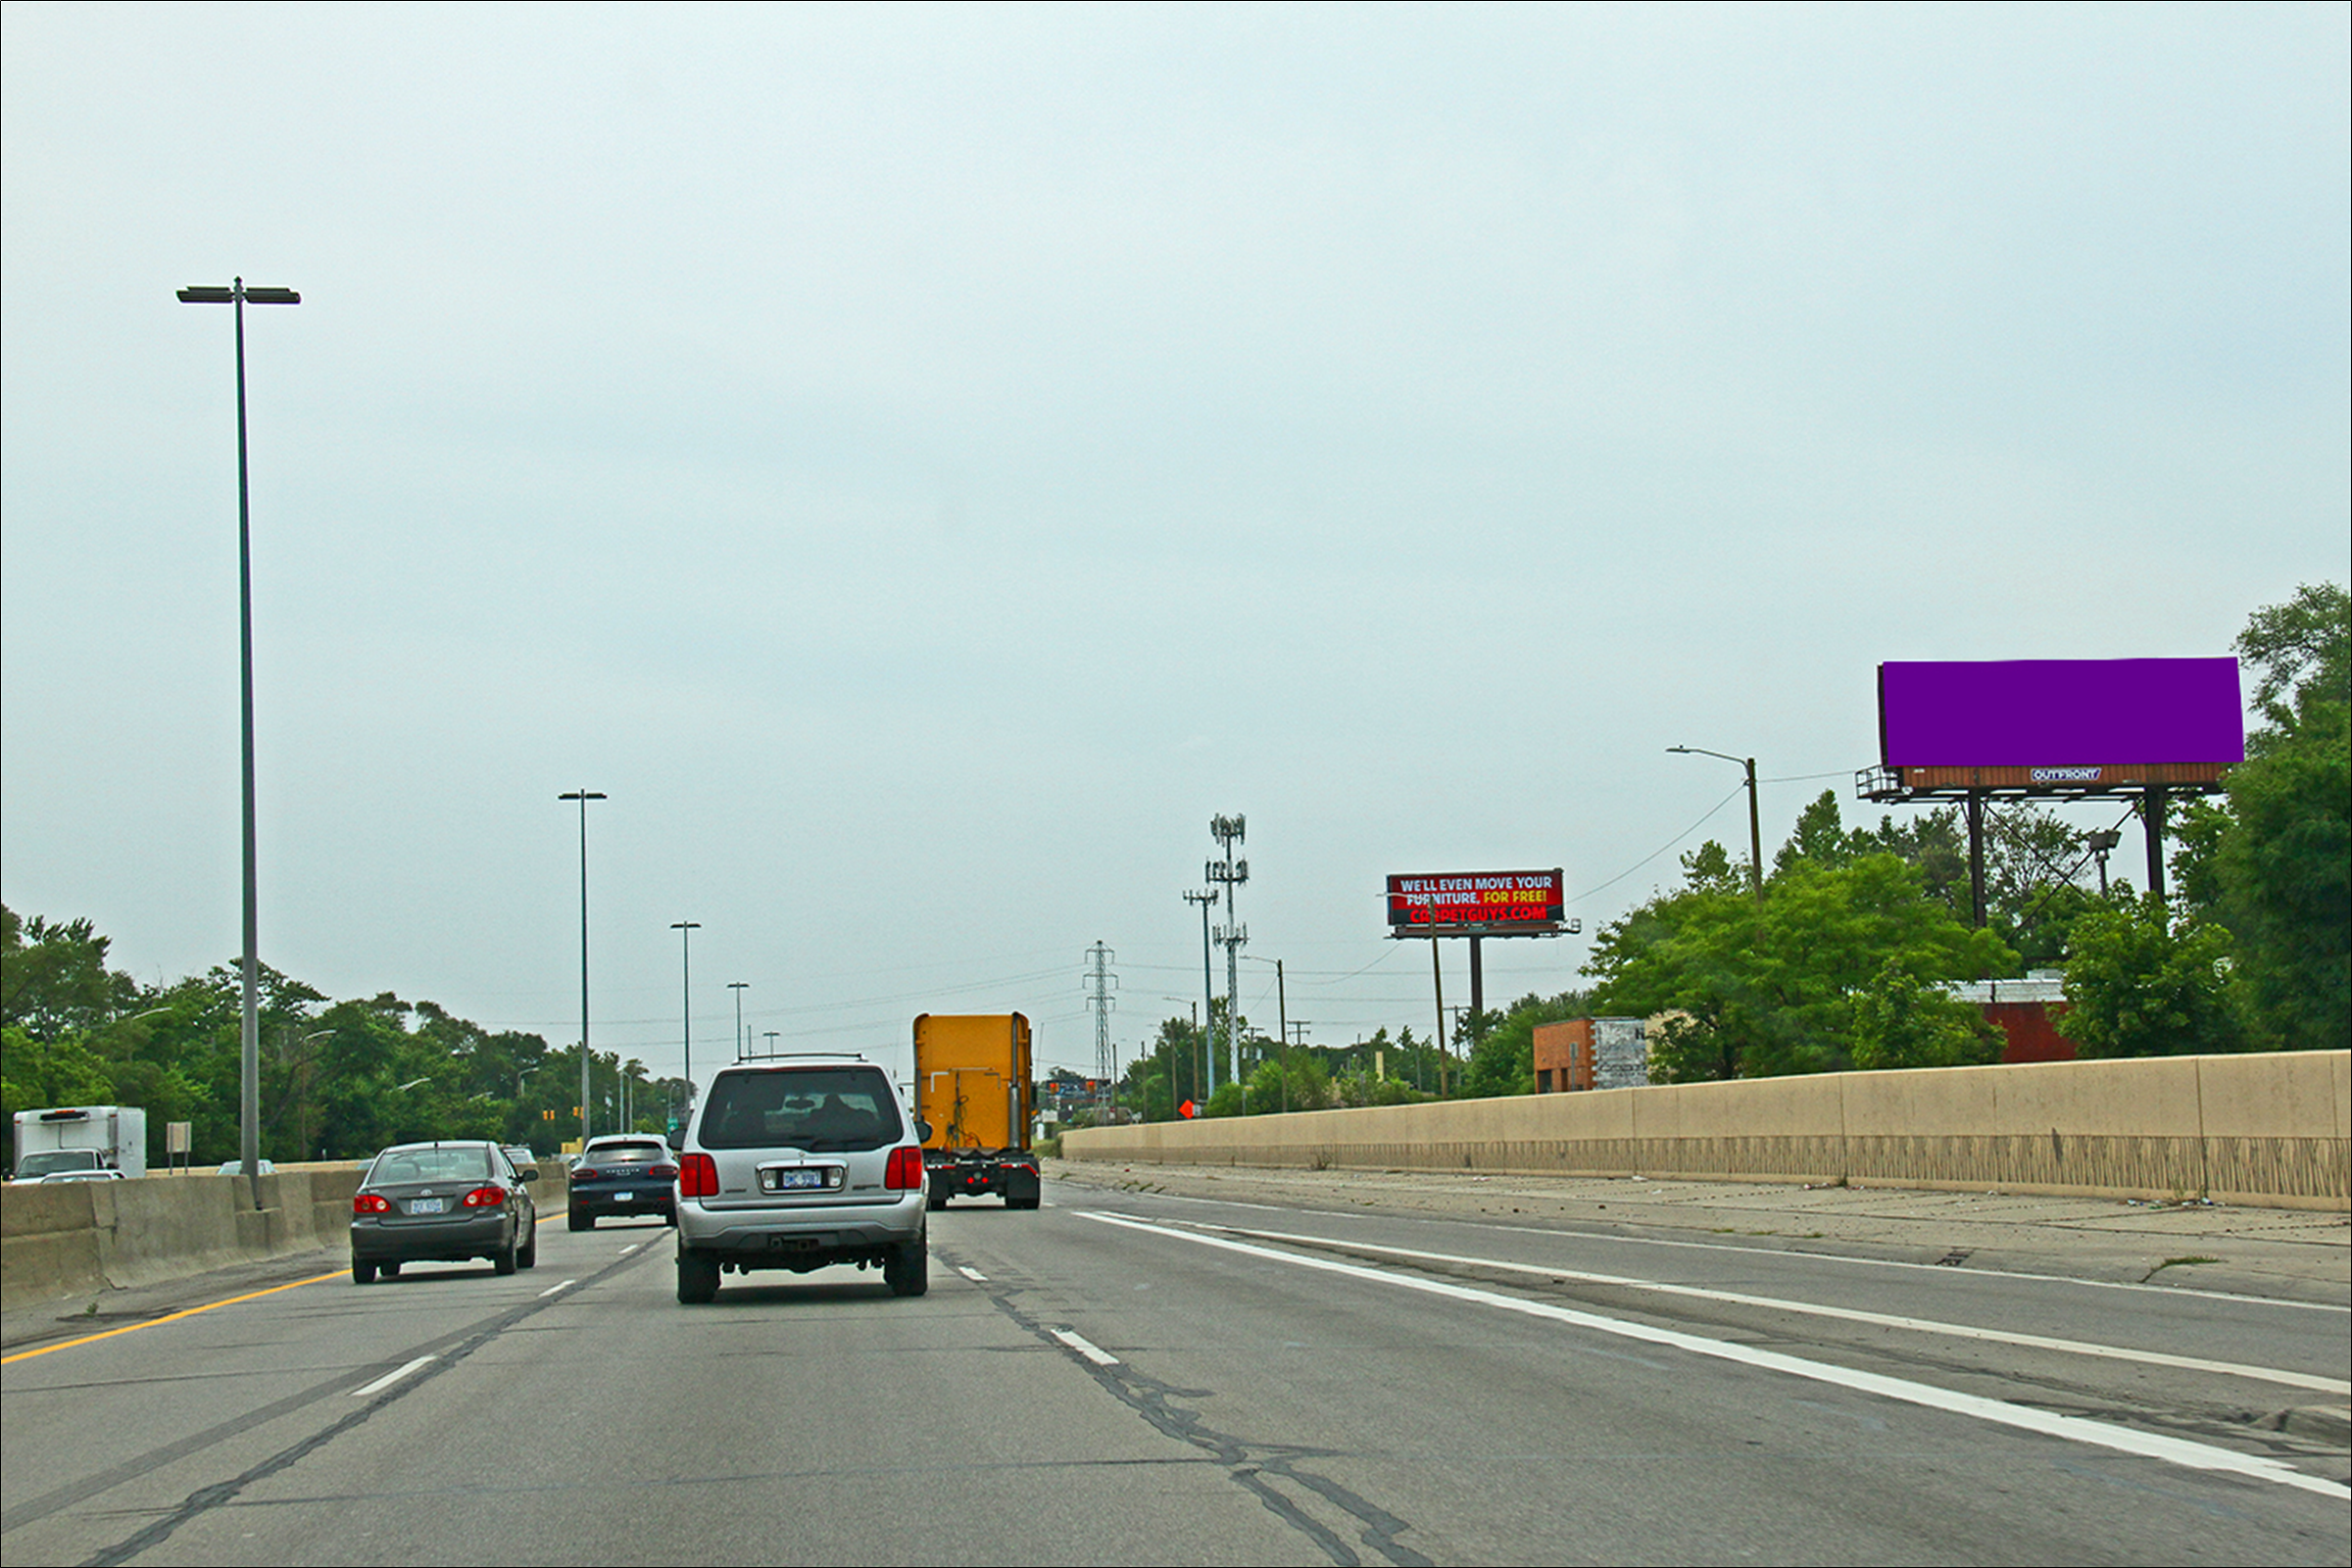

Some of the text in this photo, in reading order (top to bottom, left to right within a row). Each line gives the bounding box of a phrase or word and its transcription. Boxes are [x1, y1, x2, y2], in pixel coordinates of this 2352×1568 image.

[2034, 768, 2099, 781] OUTFRONT
[1400, 876, 1552, 892] WE'LL EVEN MOVE YOUR
[1406, 890, 1547, 906] FURNITURE, FOR FREE!
